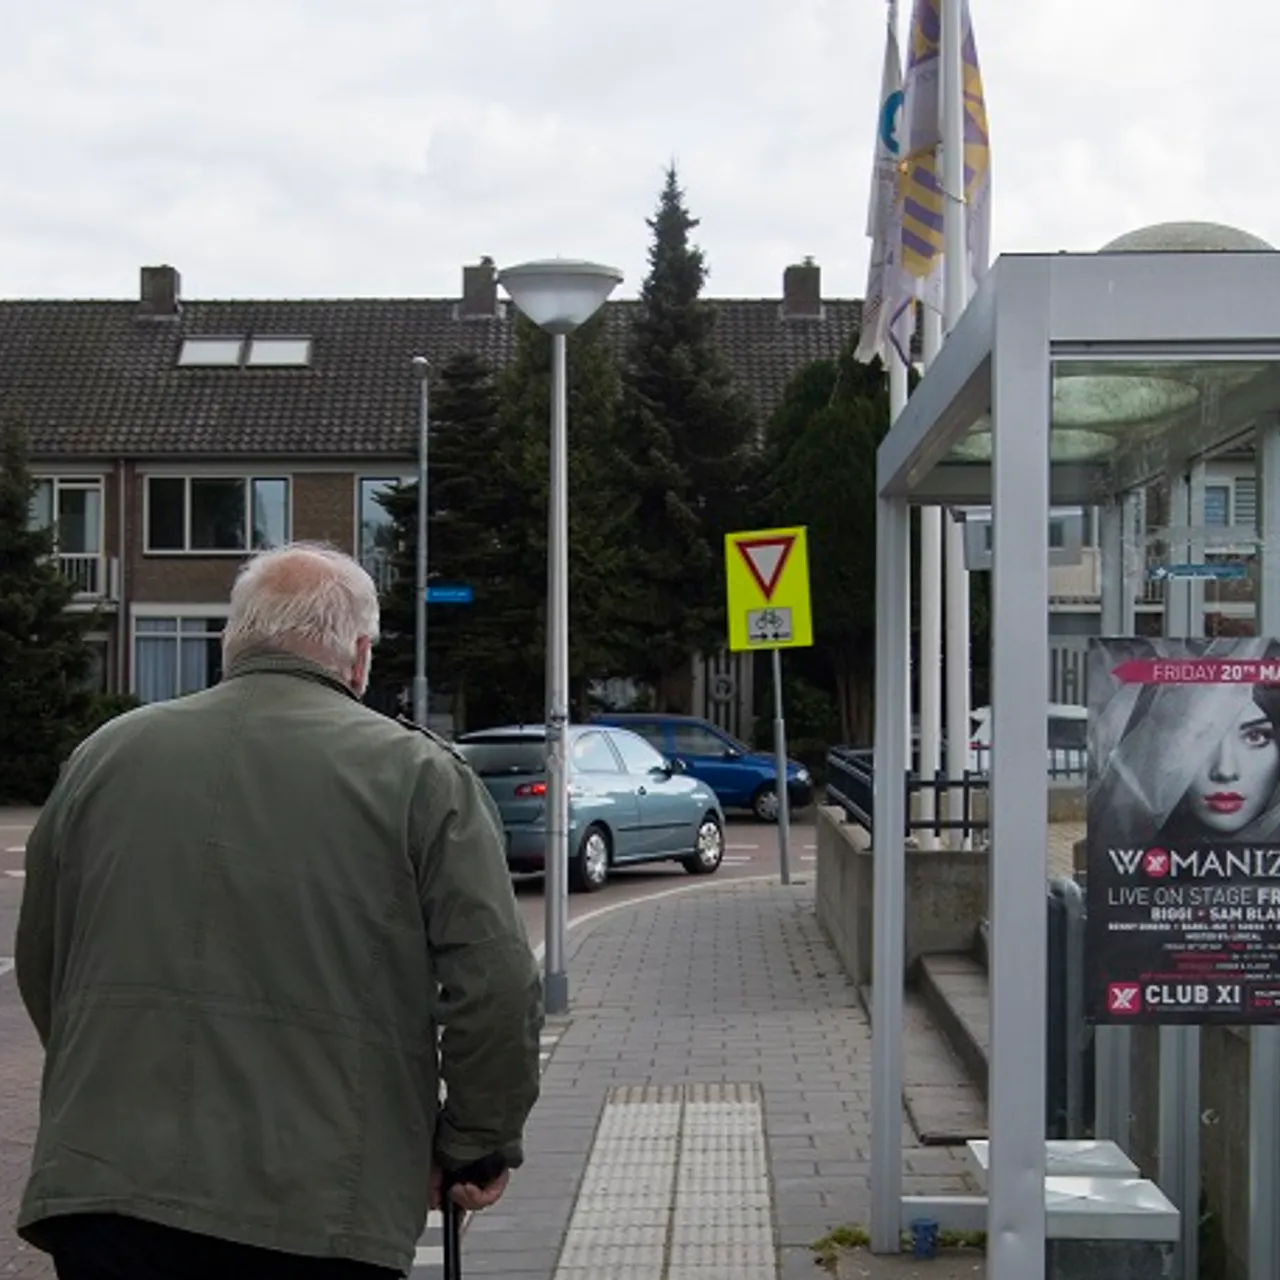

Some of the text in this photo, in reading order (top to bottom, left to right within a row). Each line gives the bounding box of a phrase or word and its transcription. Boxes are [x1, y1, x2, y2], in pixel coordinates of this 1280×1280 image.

[1153, 664, 1217, 680] FRIDAY
[1108, 887, 1149, 905] LIVE
[1154, 887, 1183, 905] ON
[1189, 887, 1252, 905] STAGE
[1151, 907, 1192, 921] BIGGI
[1210, 907, 1242, 921] SAM
[1145, 985, 1209, 1004] CLUB
[1217, 985, 1240, 1004] XI
